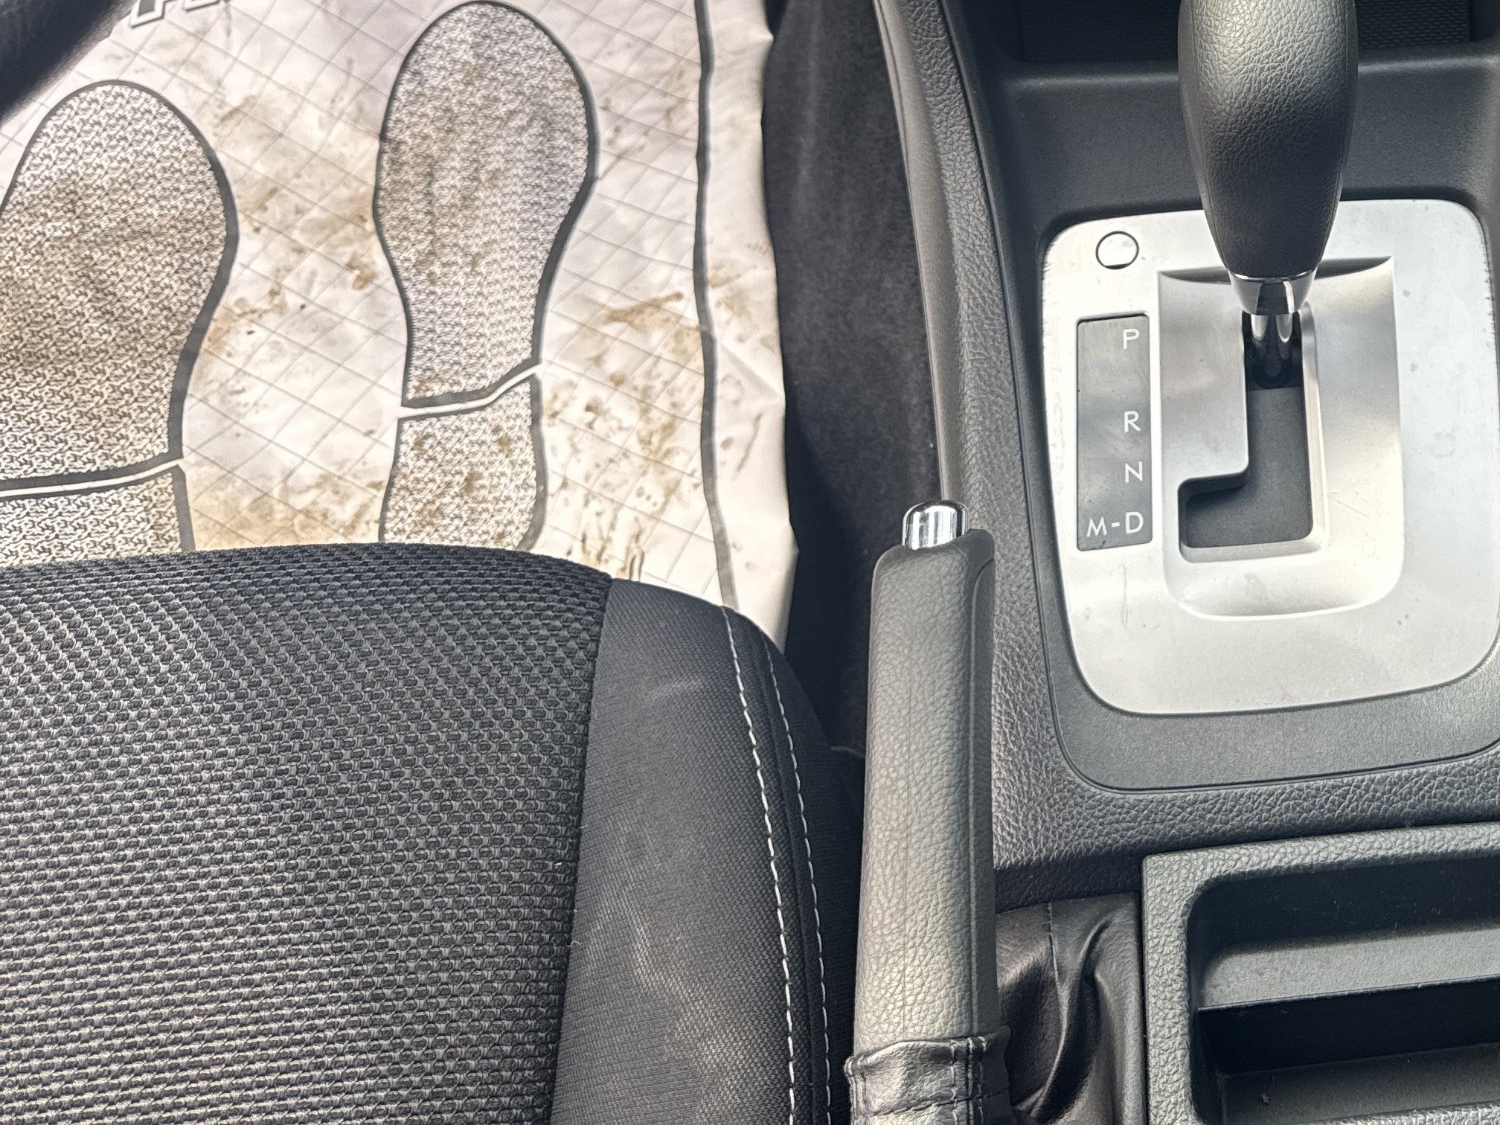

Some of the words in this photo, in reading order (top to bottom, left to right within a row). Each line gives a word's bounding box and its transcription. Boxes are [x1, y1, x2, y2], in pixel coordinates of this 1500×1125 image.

[1122, 328, 1140, 350] P
[1123, 410, 1142, 434] R
[1125, 461, 1144, 483] N
